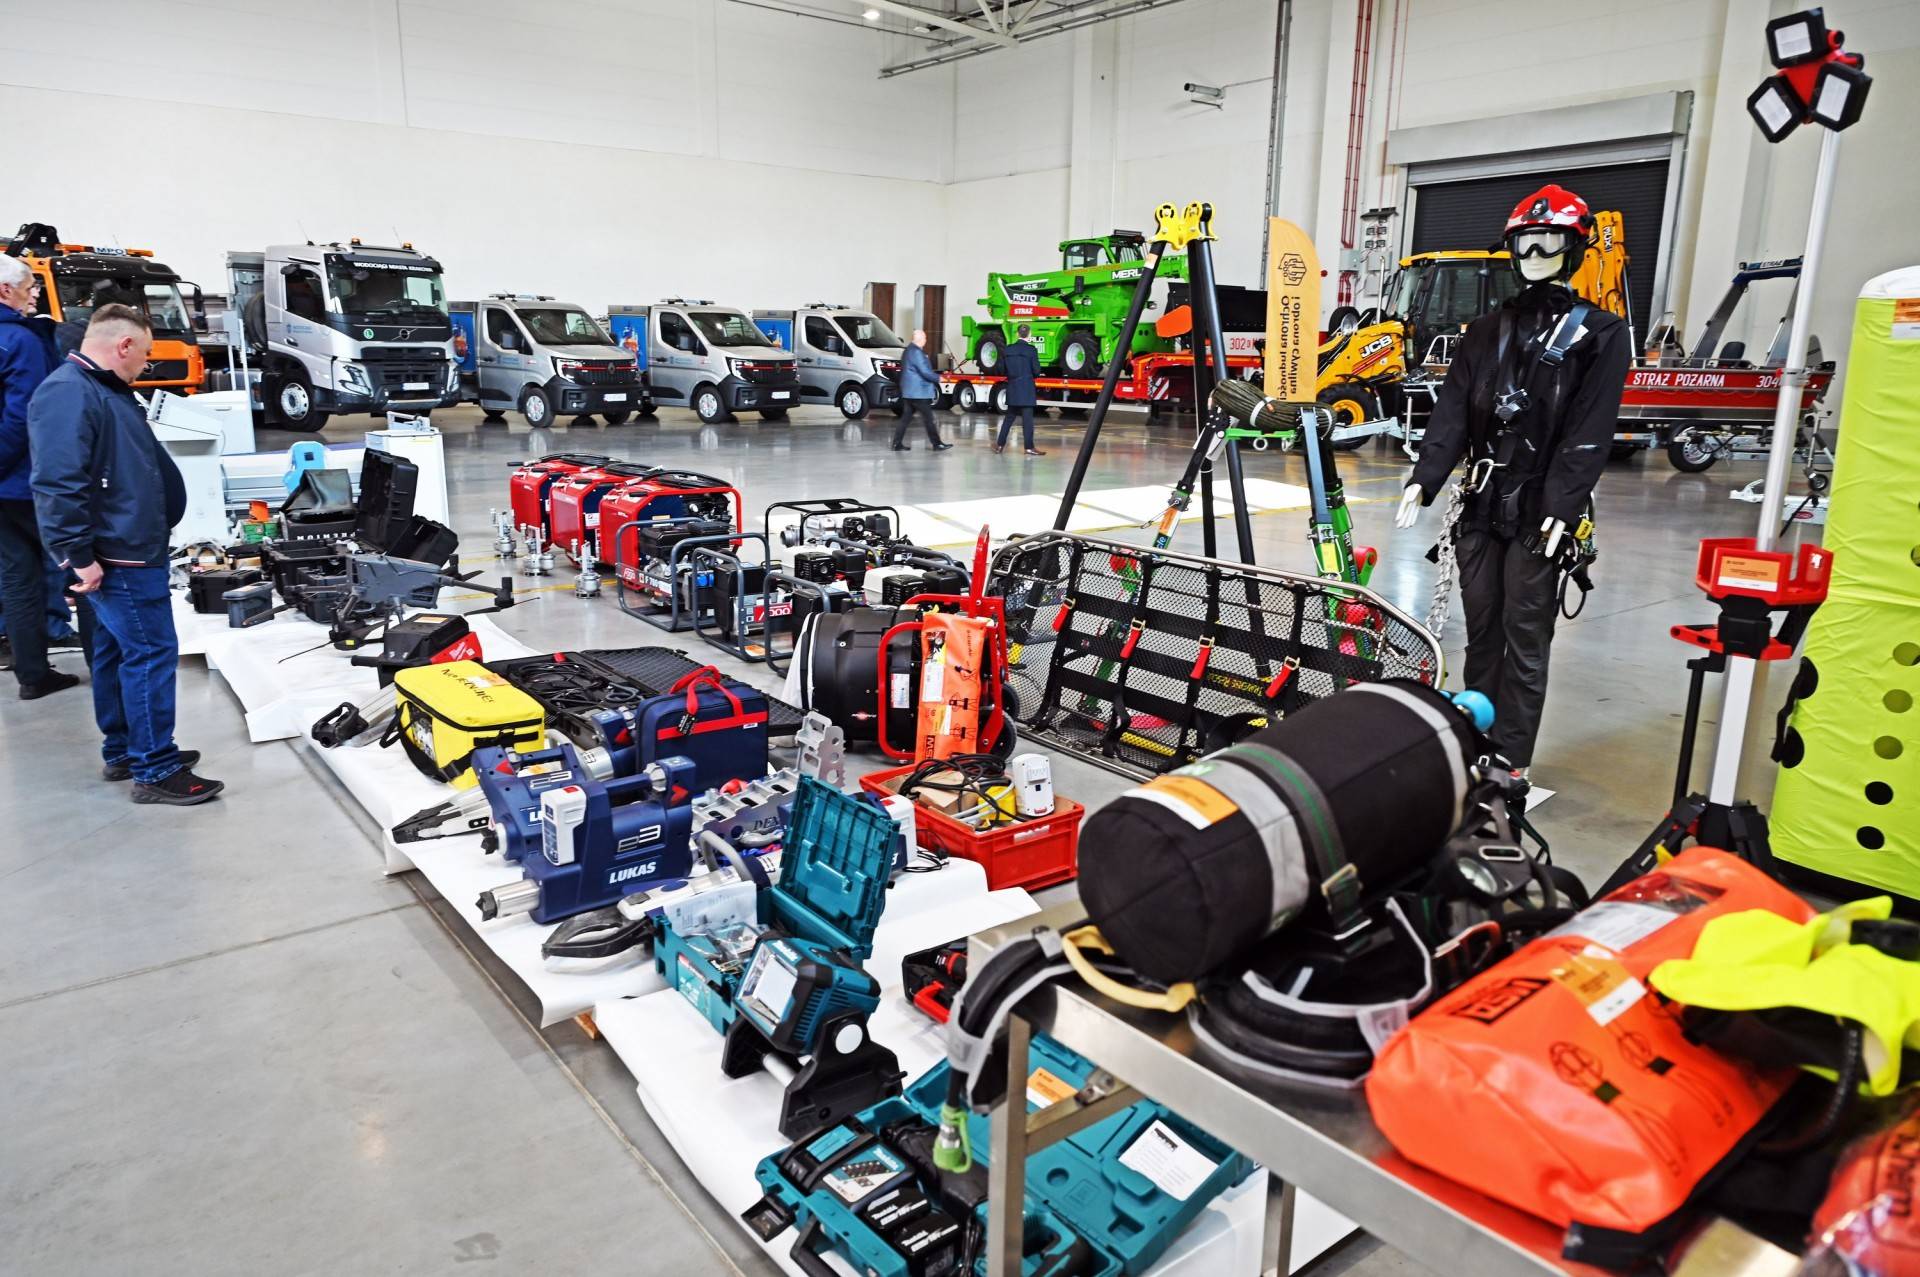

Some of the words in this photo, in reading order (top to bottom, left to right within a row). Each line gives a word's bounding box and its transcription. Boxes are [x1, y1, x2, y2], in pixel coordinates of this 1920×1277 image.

[1111, 268, 1142, 280] MERL
[1013, 293, 1037, 302] ROTO
[1361, 335, 1393, 358] JCB
[297, 531, 356, 541] PREMIUM
[609, 861, 657, 884] LUKAS
